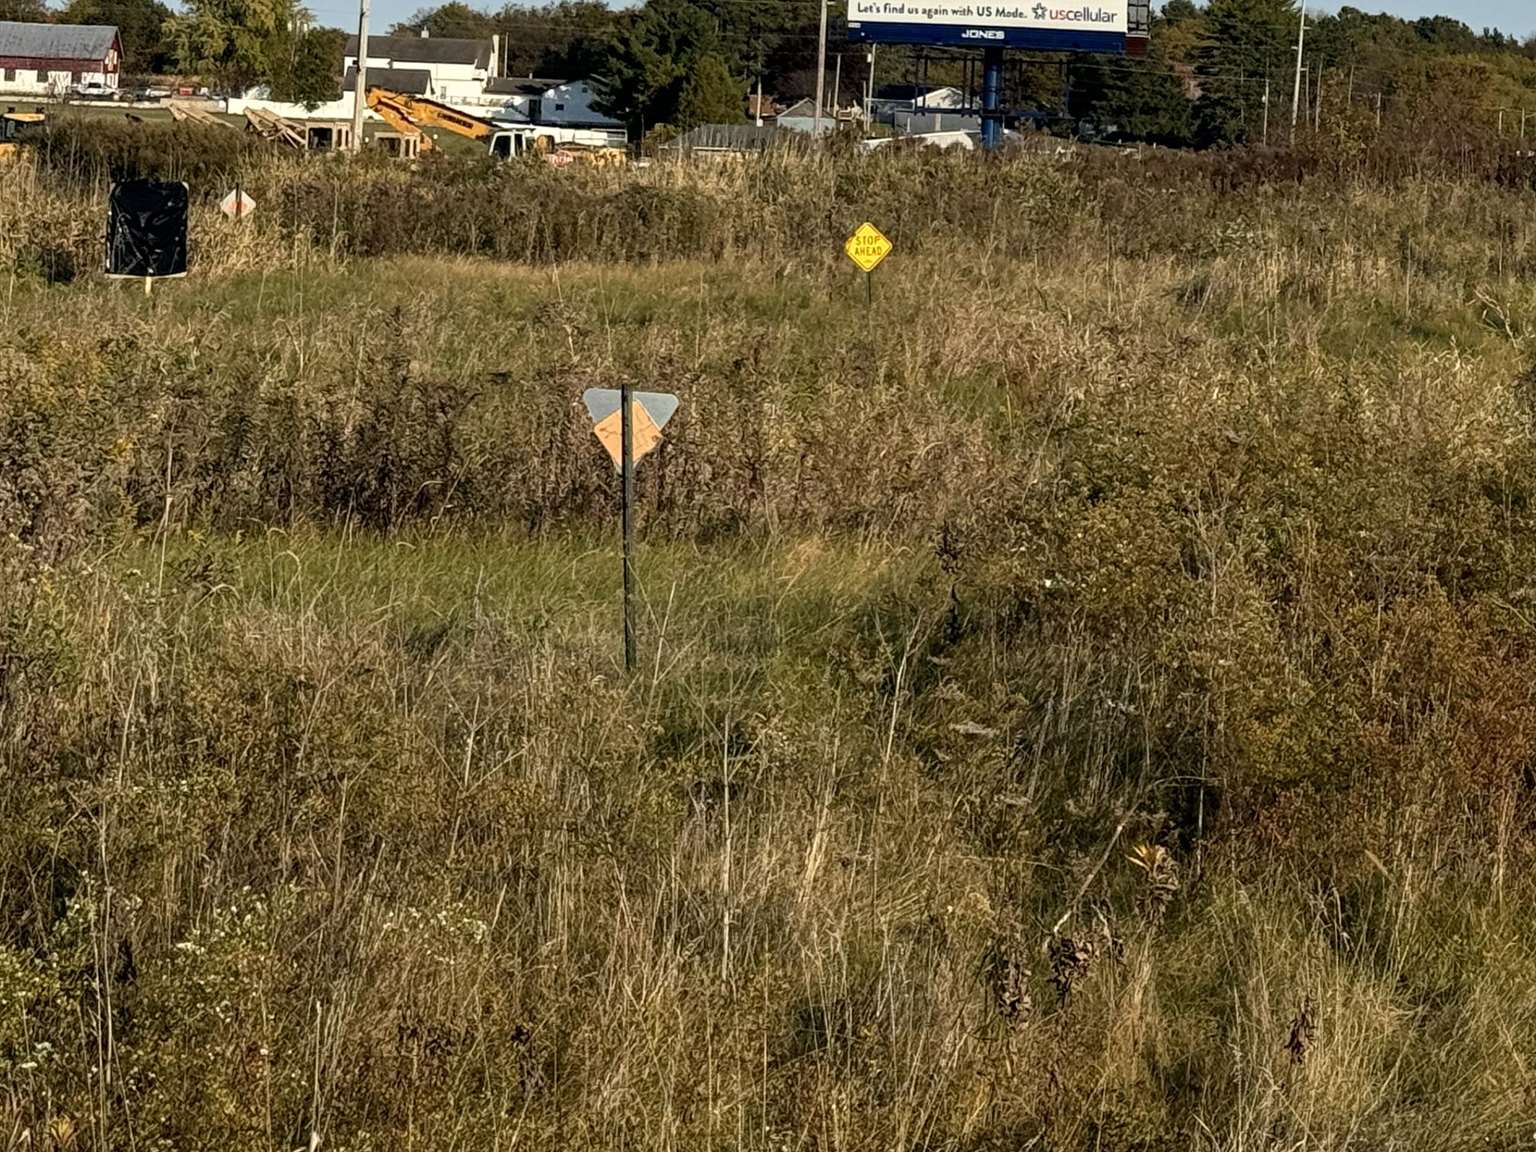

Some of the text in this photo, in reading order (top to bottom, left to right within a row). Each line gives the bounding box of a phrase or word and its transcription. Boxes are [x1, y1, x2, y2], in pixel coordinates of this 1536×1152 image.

[857, 1, 1028, 19] Let's find us again with US Mode.
[1049, 7, 1118, 23] uscellular
[961, 29, 1005, 40] JONES
[855, 235, 881, 246] STOP
[854, 246, 882, 257] AHEAD
